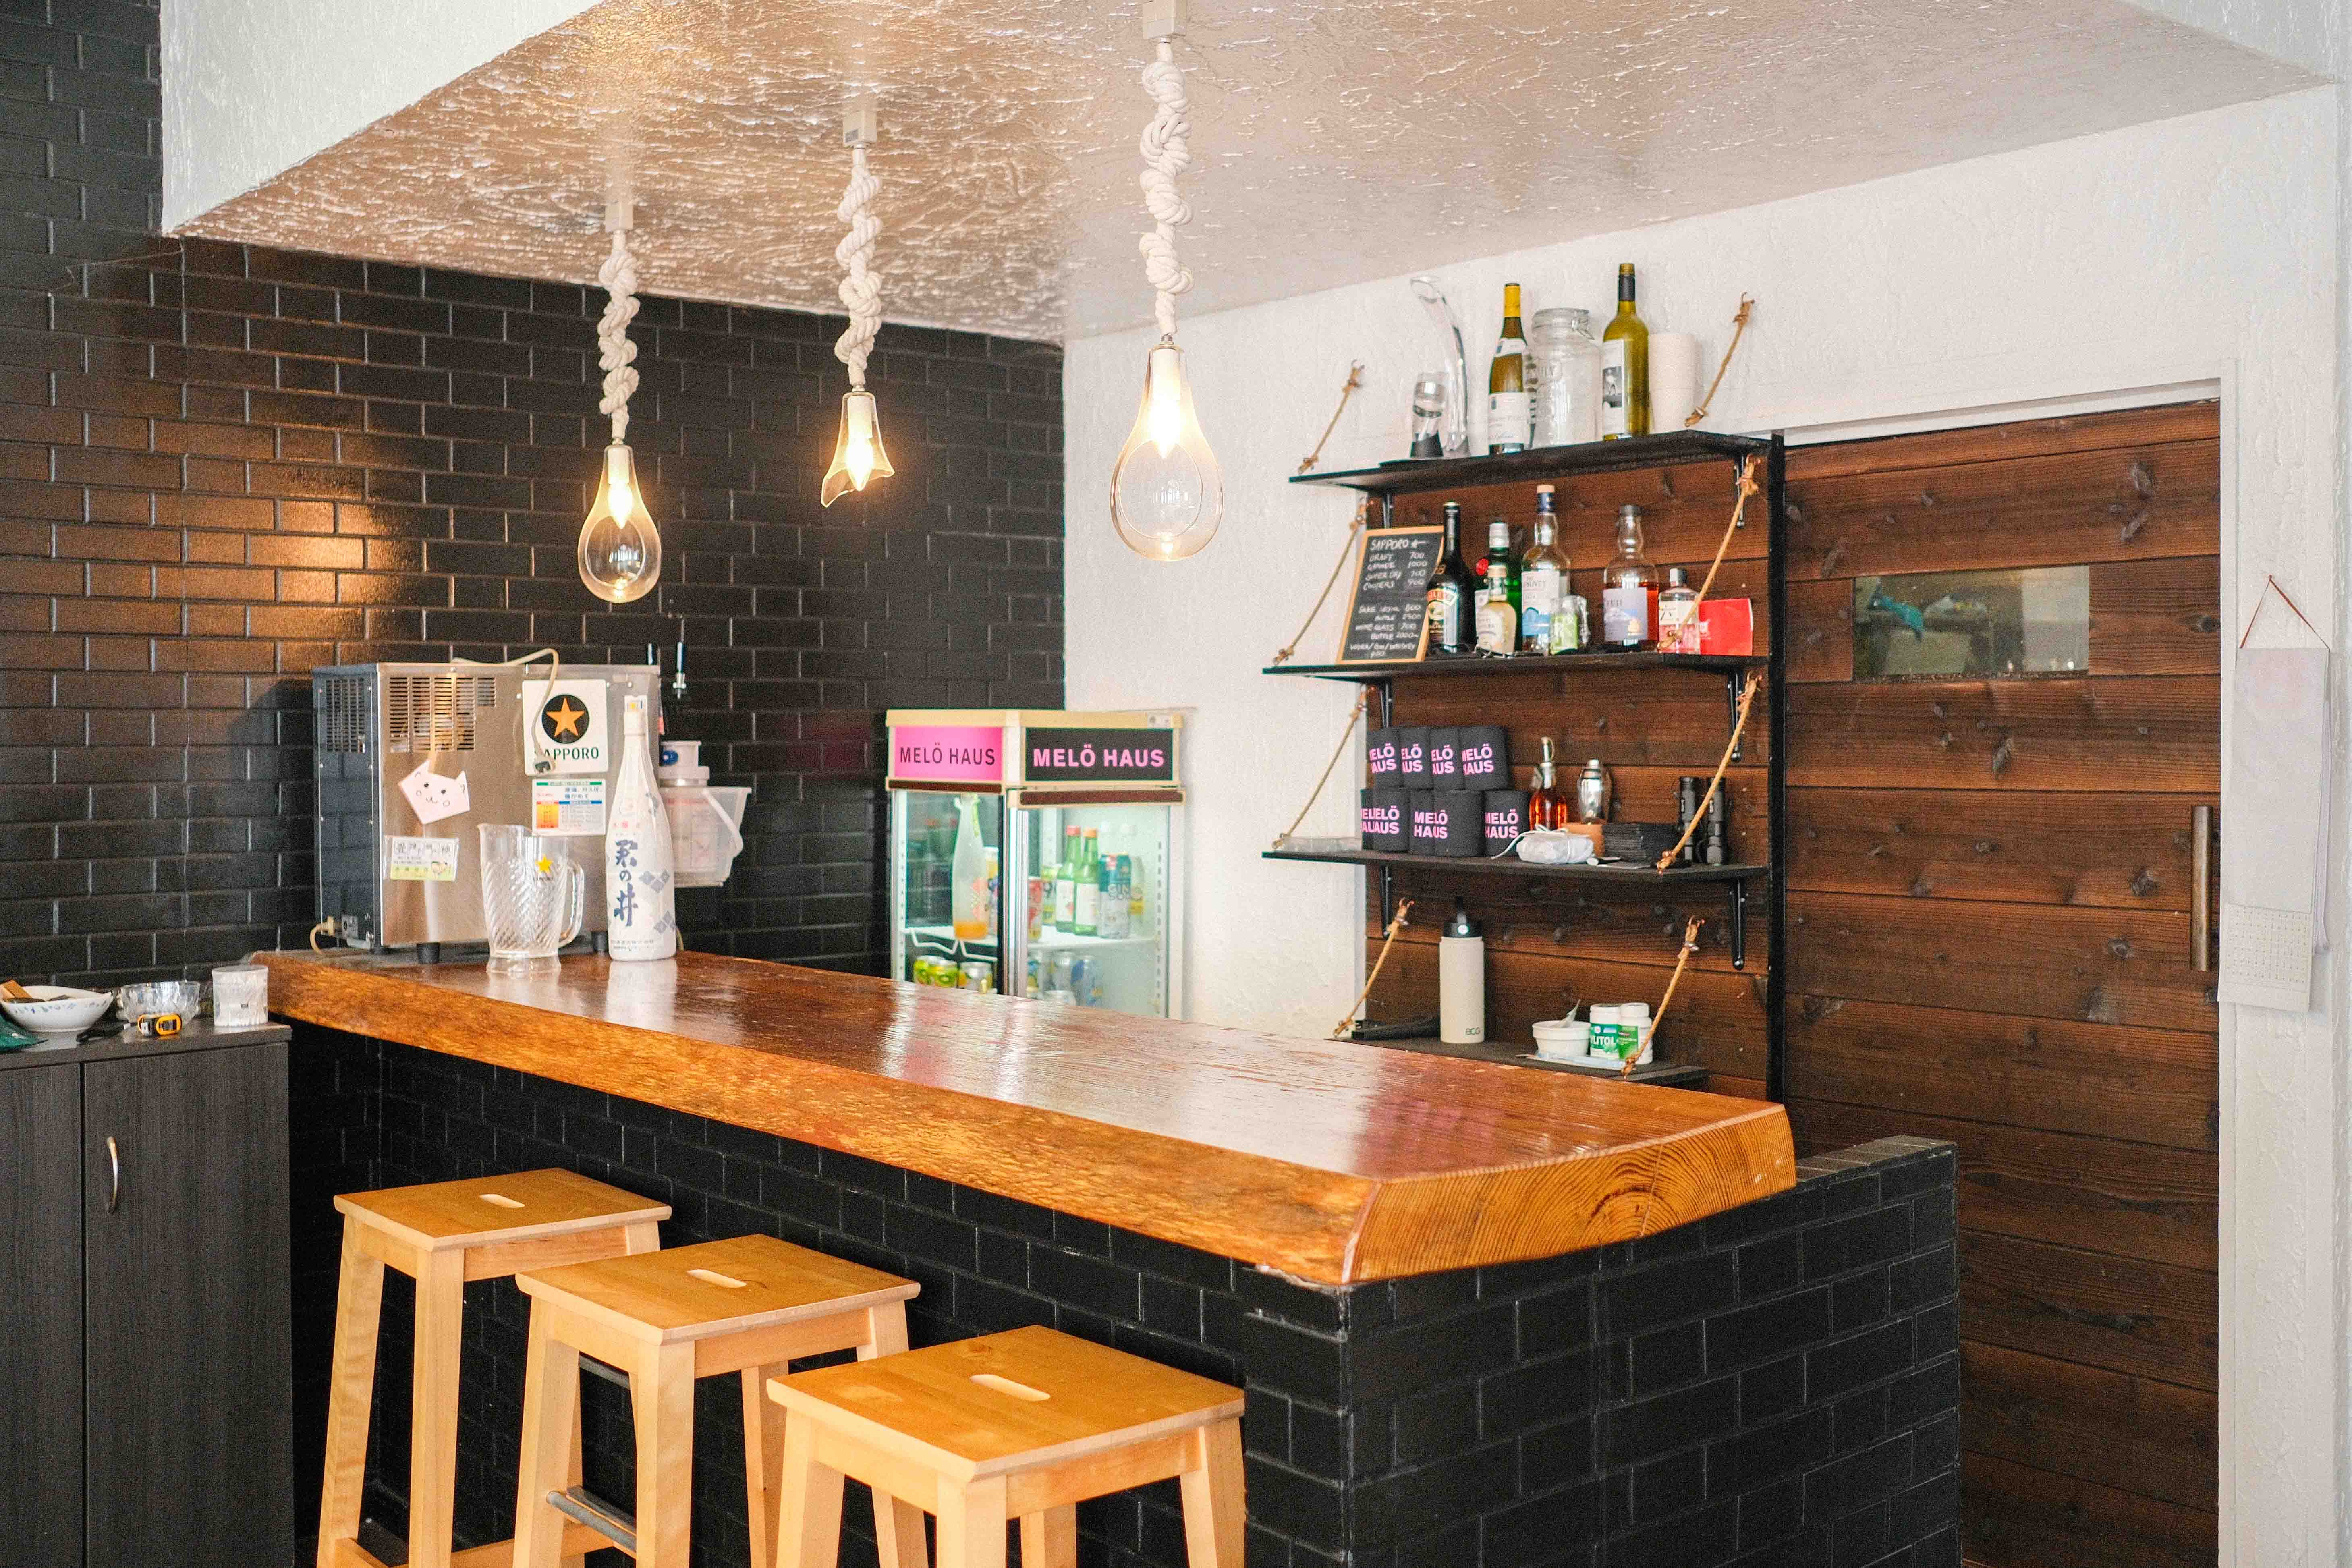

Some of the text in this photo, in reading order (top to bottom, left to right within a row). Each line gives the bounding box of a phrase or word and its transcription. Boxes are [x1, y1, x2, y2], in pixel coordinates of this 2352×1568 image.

[1370, 539, 1409, 551] SAPPORO
[535, 747, 599, 761] APPORO
[900, 742, 996, 765] MELÖ HAUS
[1033, 743, 1164, 768] MELÖ HAUS
[1369, 743, 1395, 761] ELÖ
[1401, 744, 1422, 760] ELÖ
[1431, 744, 1453, 761] ELÖ
[1371, 759, 1397, 774] AUS
[1432, 761, 1454, 774] AUS
